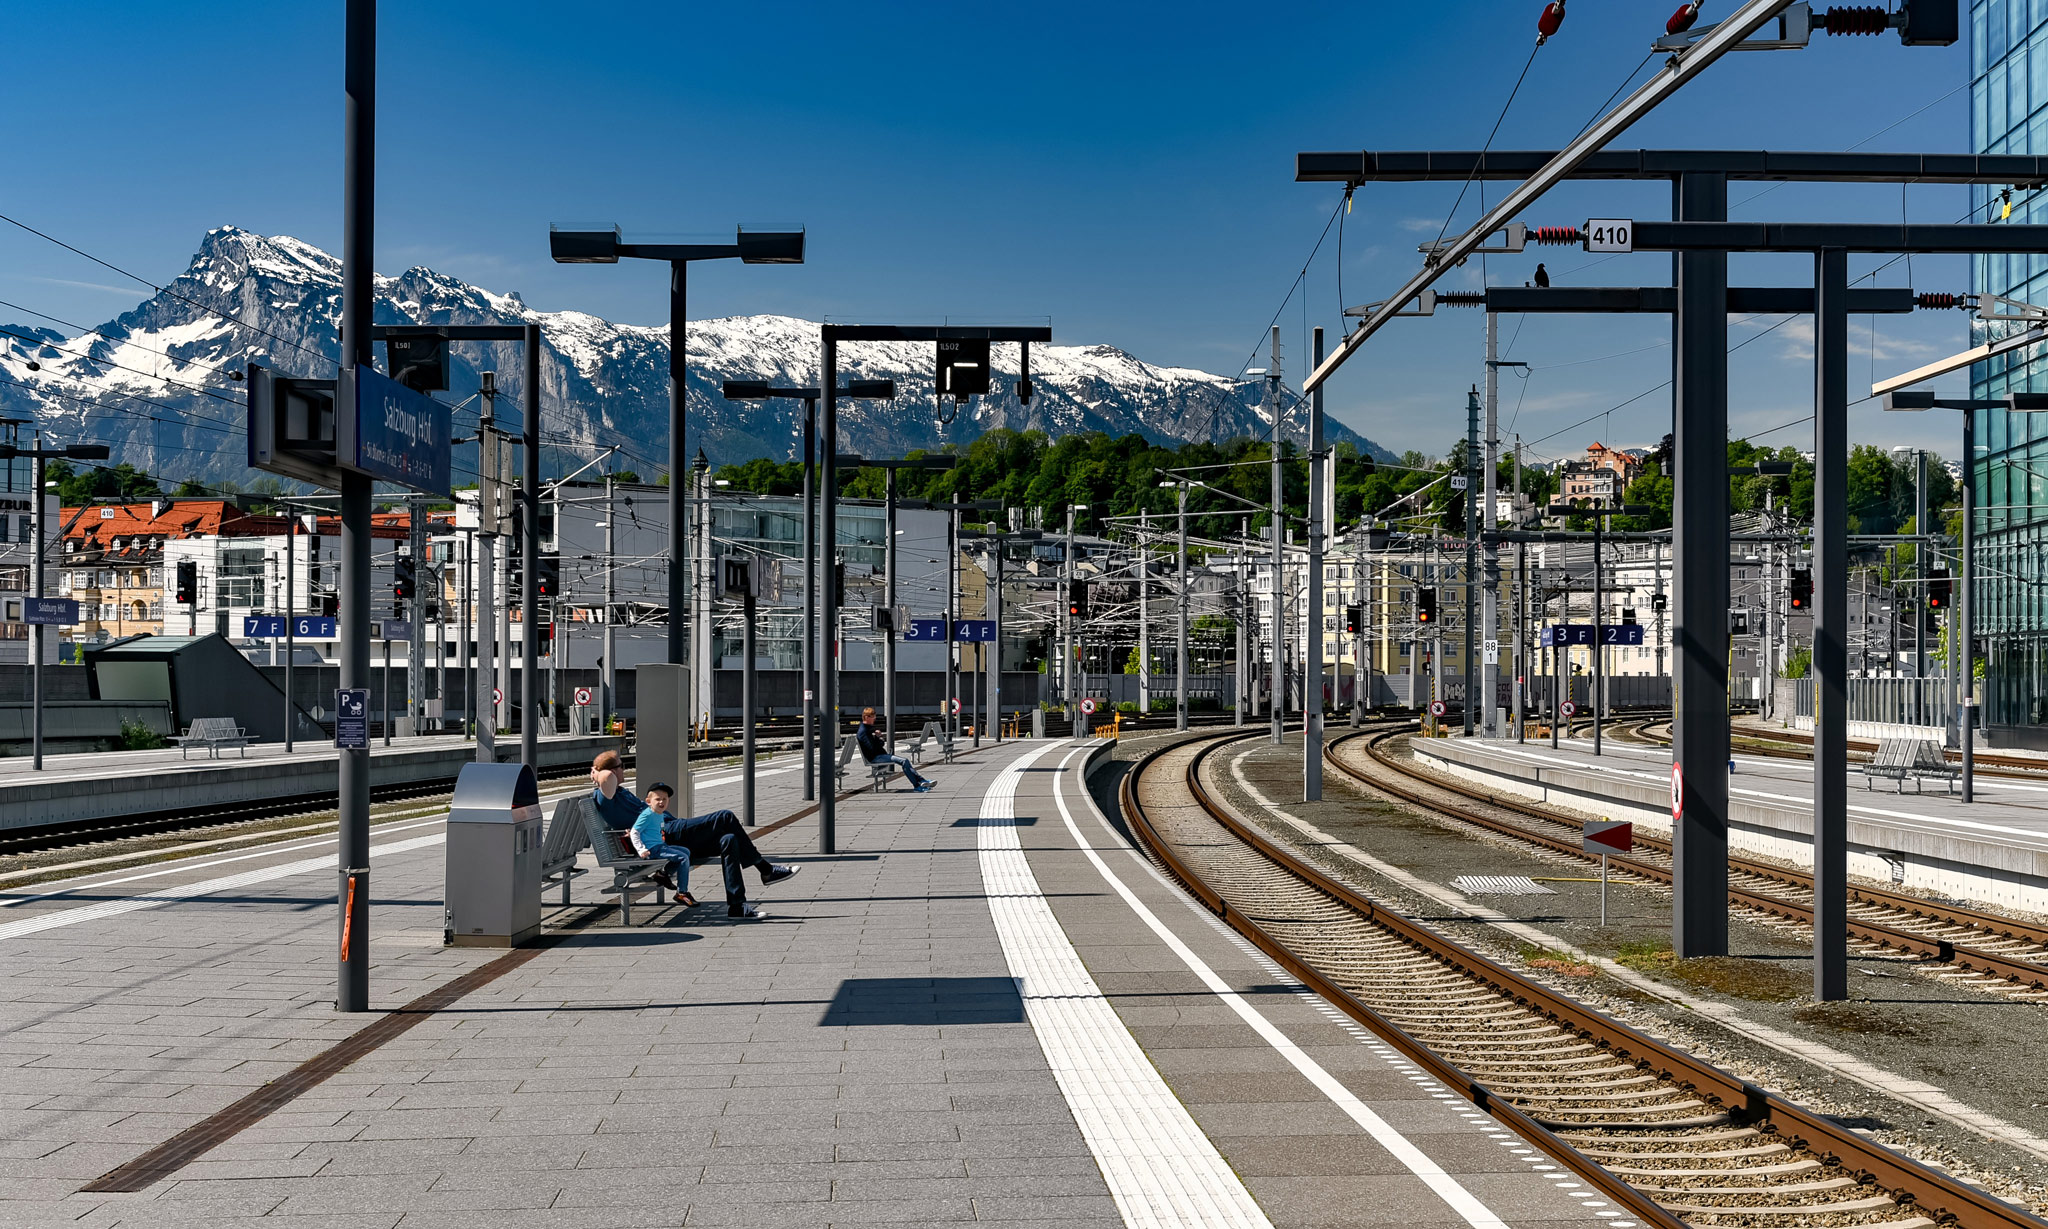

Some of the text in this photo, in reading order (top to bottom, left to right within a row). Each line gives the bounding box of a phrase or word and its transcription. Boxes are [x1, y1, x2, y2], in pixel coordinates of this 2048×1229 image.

[1592, 226, 1628, 245] 410
[383, 395, 416, 447] Salzburg
[1452, 479, 1466, 487] 410
[249, 620, 278, 634] 7 F
[299, 620, 328, 634] 6 F
[909, 623, 938, 637] 5 F
[959, 624, 988, 638] 4 F
[1557, 628, 1567, 641] 3
[1579, 631, 1586, 641] F
[1608, 628, 1636, 642] 2 F
[1485, 642, 1496, 651] 88
[1488, 653, 1493, 662] 1
[341, 694, 350, 706] P
